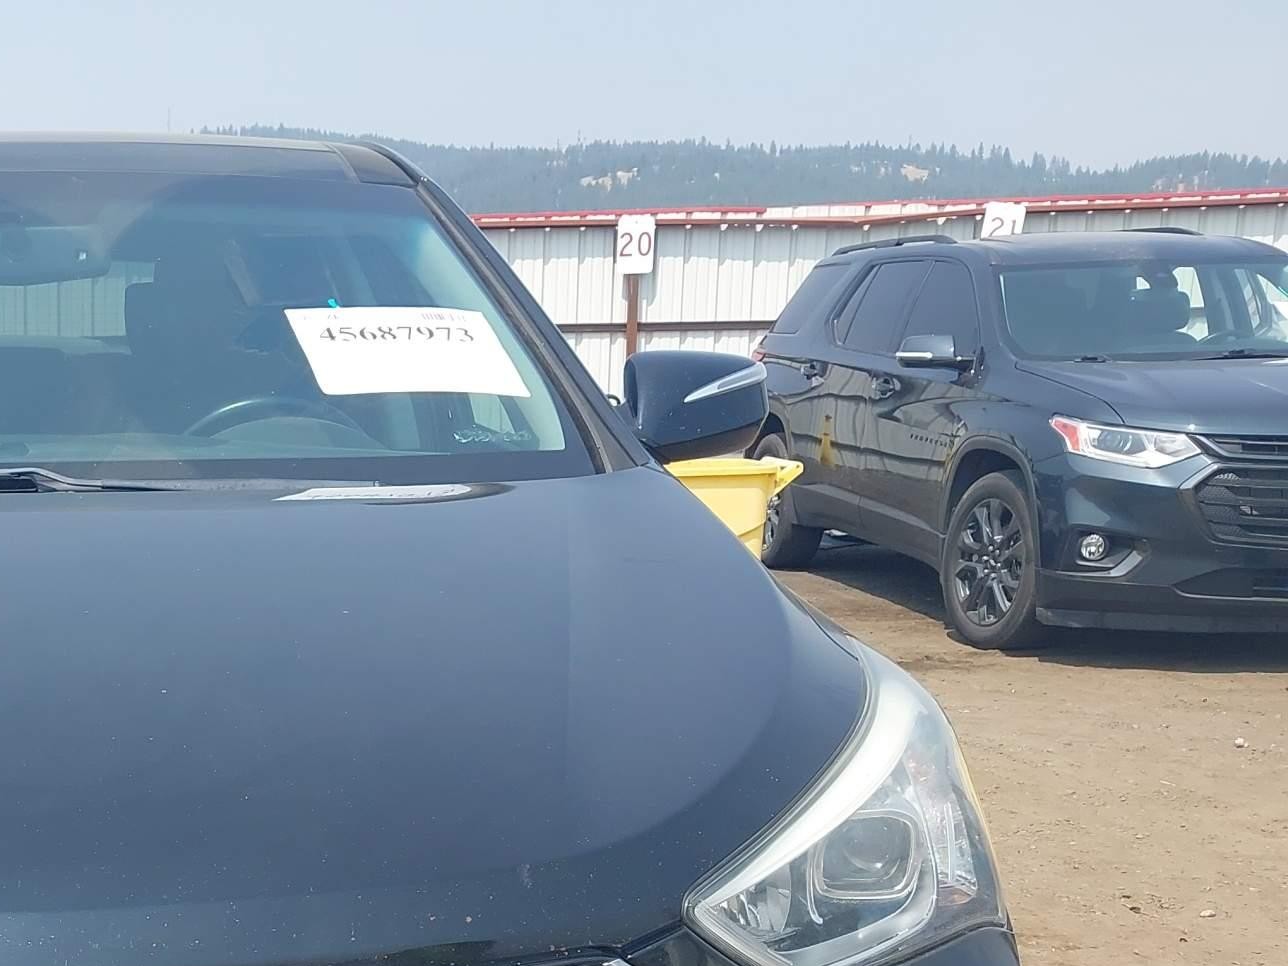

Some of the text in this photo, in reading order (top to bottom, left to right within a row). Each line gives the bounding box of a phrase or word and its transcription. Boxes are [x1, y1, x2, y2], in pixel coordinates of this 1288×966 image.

[988, 216, 1017, 236] 21
[619, 231, 652, 257] 20
[319, 325, 475, 343] 45687973
